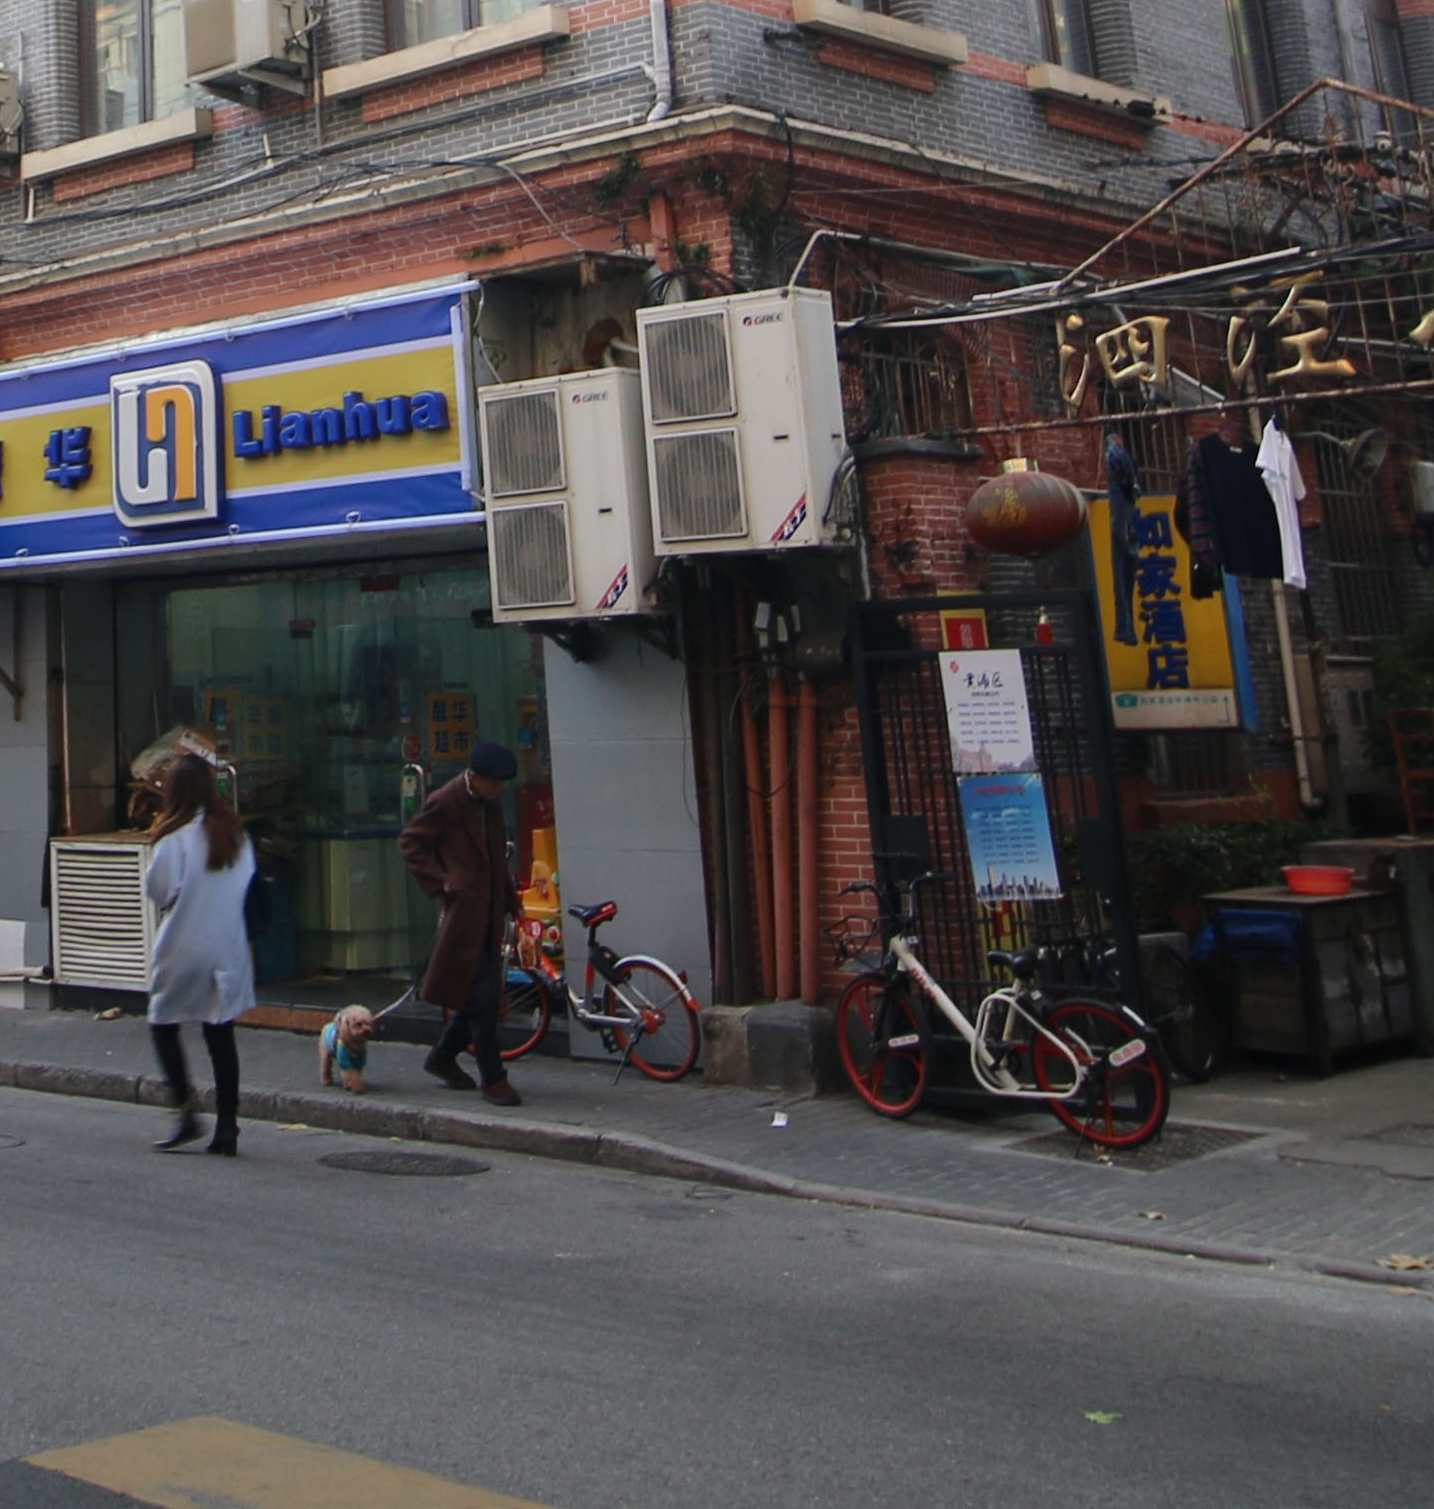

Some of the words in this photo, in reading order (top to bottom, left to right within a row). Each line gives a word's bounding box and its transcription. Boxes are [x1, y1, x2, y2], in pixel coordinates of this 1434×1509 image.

[233, 390, 450, 458] Lianhua
[1133, 507, 1190, 688] 如家酒店
